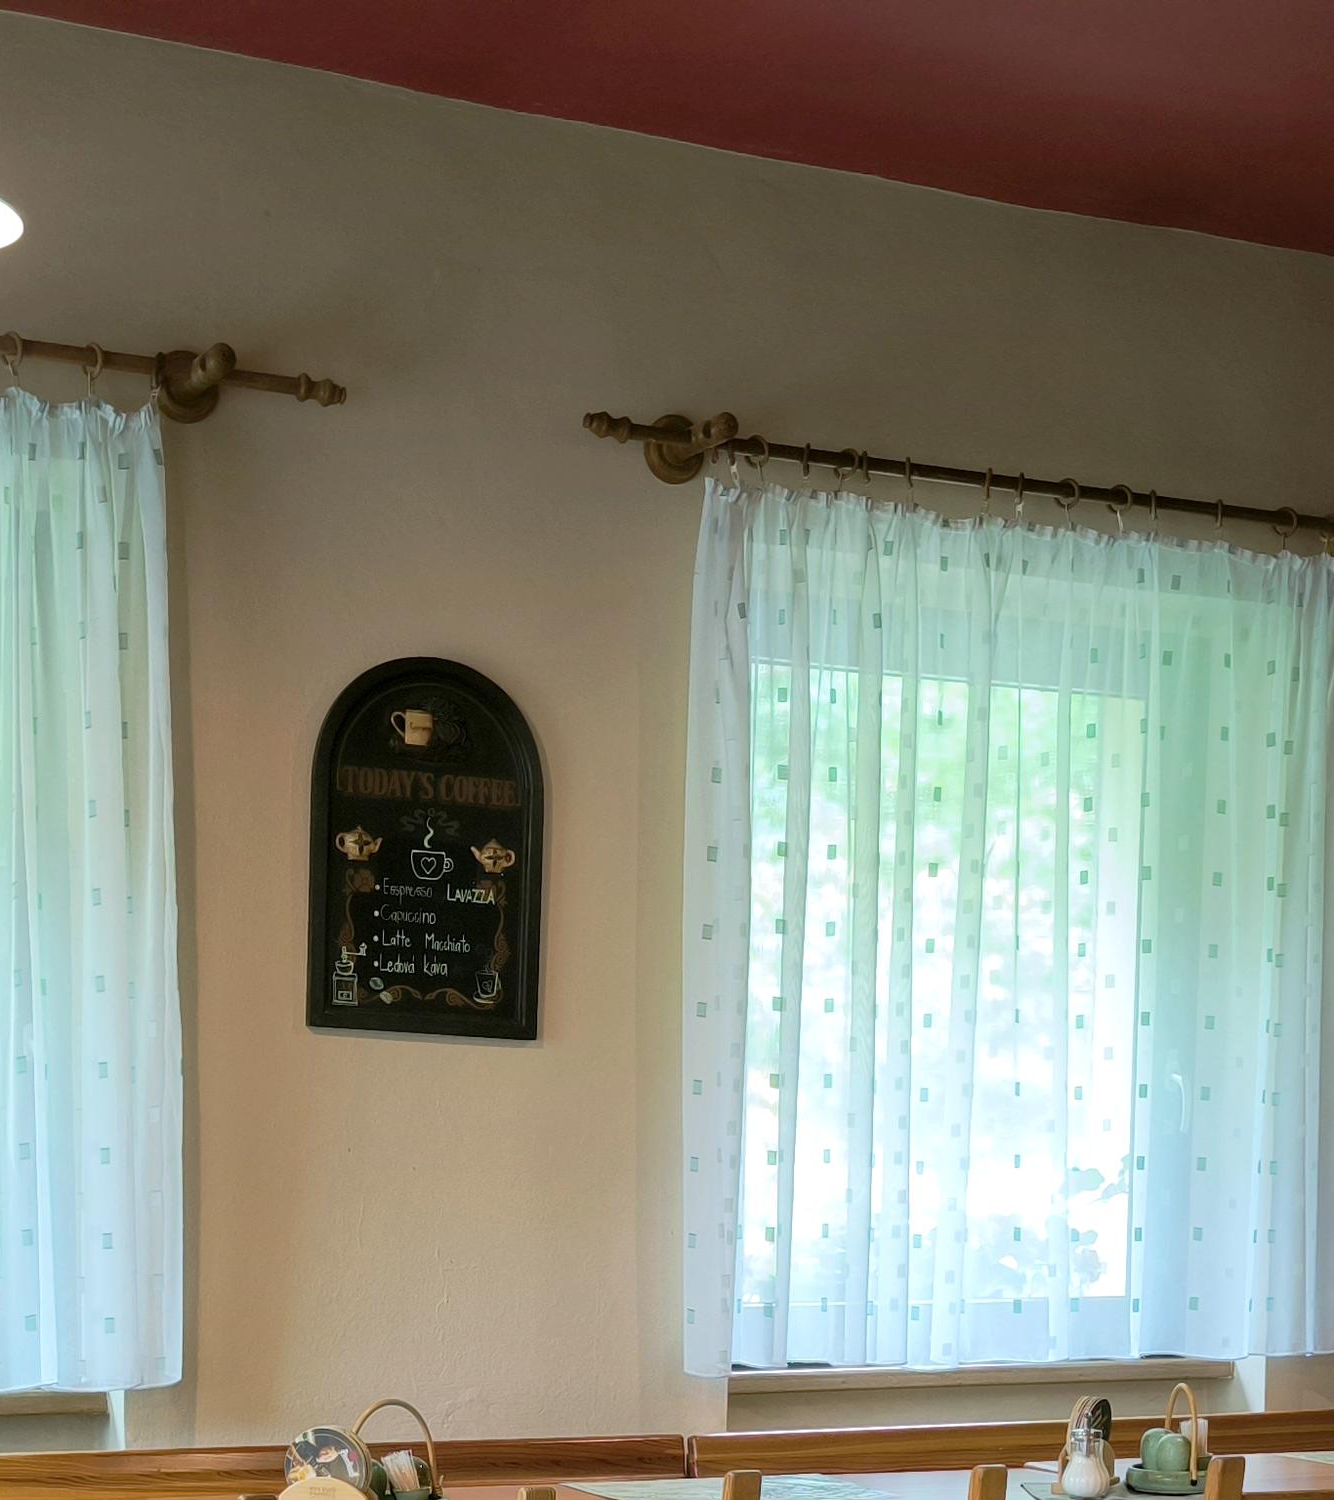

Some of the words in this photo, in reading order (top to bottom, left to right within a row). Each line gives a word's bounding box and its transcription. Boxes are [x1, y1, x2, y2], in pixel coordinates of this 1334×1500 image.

[337, 766, 435, 800] TODAY'S
[439, 774, 521, 807] COFFEE
[447, 883, 496, 906] LAVAZZA
[382, 929, 412, 948] Latte
